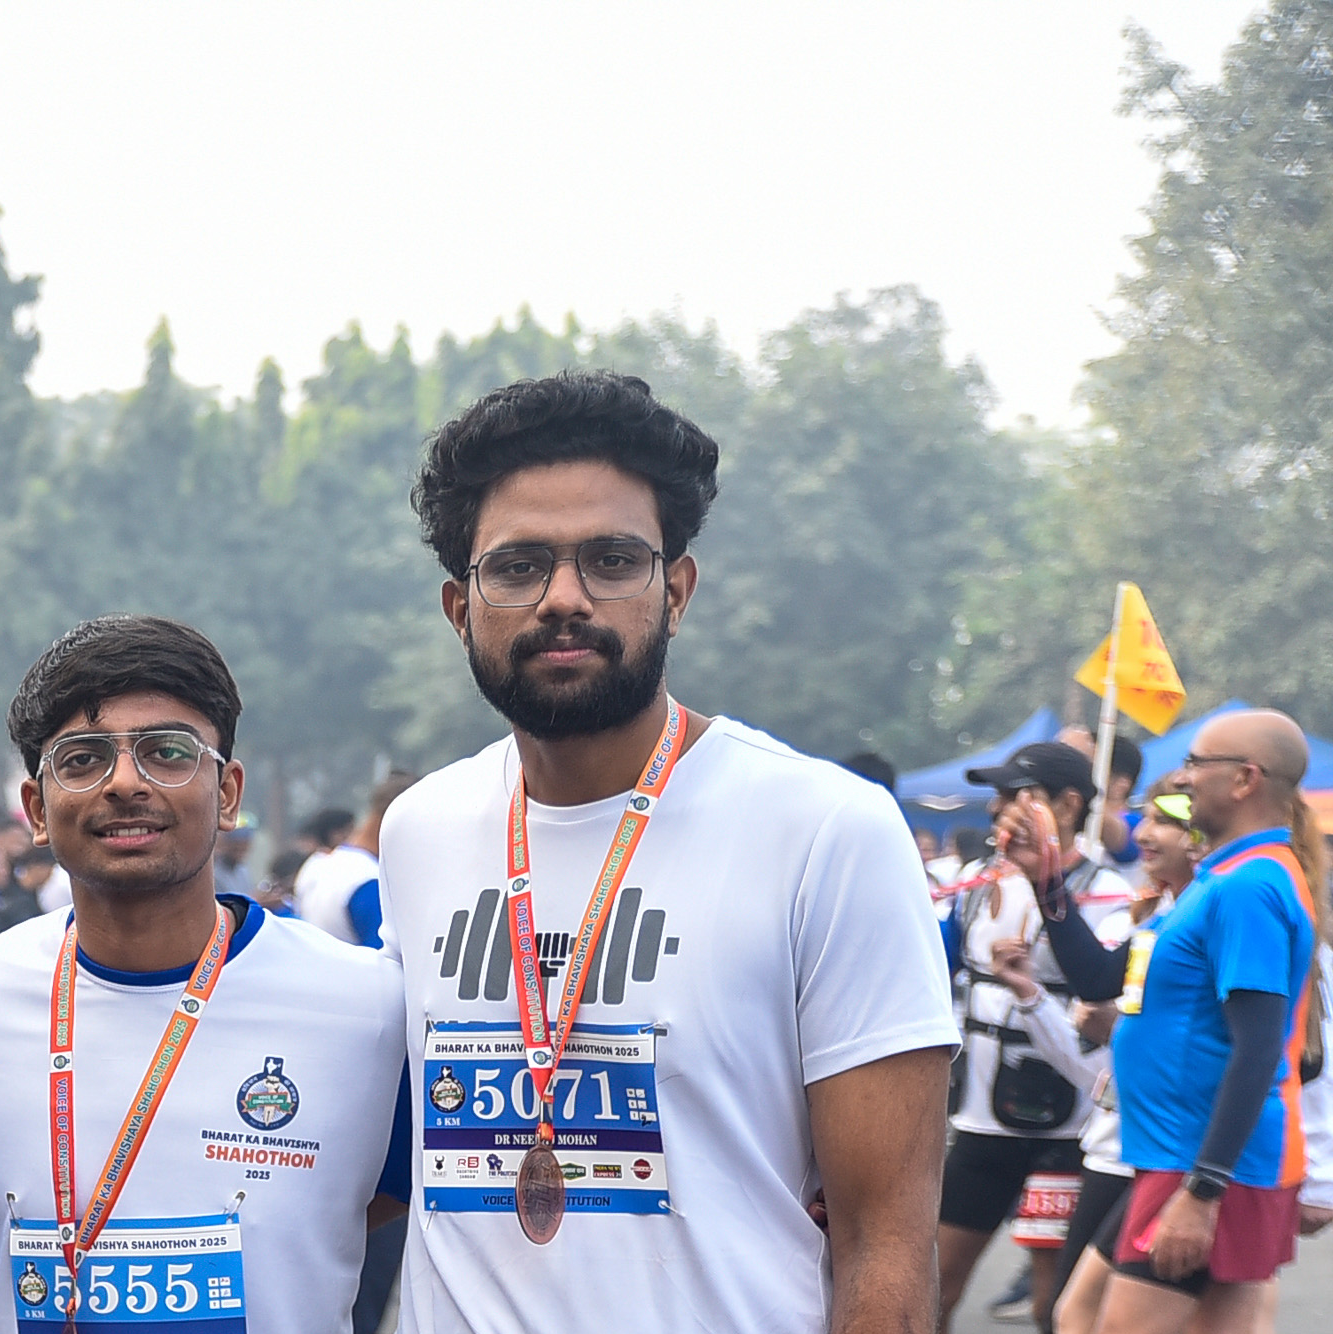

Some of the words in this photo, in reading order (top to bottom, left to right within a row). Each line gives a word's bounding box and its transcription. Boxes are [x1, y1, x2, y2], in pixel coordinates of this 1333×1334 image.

[643, 753, 667, 788] VOICE
[661, 737, 672, 753] OF
[589, 847, 624, 920] SHAHOTHON
[619, 818, 638, 845] 2025
[516, 900, 529, 933] VOICE
[519, 937, 531, 953] OF
[194, 959, 216, 991] VOICE
[210, 944, 222, 959] OF
[567, 922, 595, 997] BHAVISHAYA
[58, 952, 71, 1019] SHAHOTHON
[522, 956, 546, 1043] CONSTITUTION
[563, 999, 572, 1016] KA
[56, 1020, 68, 1046] 2025
[435, 1043, 474, 1054] BHARAT
[477, 1043, 492, 1053] KA
[615, 1047, 639, 1056] 2025
[56, 1078, 68, 1113] VOICE
[472, 1067, 621, 1120] 5071
[57, 1115, 69, 1131] OF
[80, 1200, 105, 1244] BHARAT
[99, 1182, 113, 1200] KA
[107, 1115, 144, 1183] BHAVISHAYA
[137, 1044, 175, 1114] SHAHOTHON
[169, 1019, 187, 1046] 2025
[436, 1118, 442, 1126] 5
[444, 1117, 460, 1126] KM
[201, 1130, 244, 1143] BHARAT
[245, 1135, 260, 1145] KA
[262, 1136, 320, 1151] BHAVISHYA
[494, 1134, 511, 1145] DR
[558, 1134, 597, 1145] MOHAN
[205, 1144, 315, 1169] SHAHOTHON
[245, 1169, 271, 1180] 2025
[483, 1196, 513, 1205] VOICE
[18, 1241, 53, 1250] BHARAT
[131, 1238, 198, 1249] SHAHOTHON
[199, 1237, 227, 1248] 2025
[53, 1262, 199, 1315] 5555
[32, 1311, 46, 1319] KM
